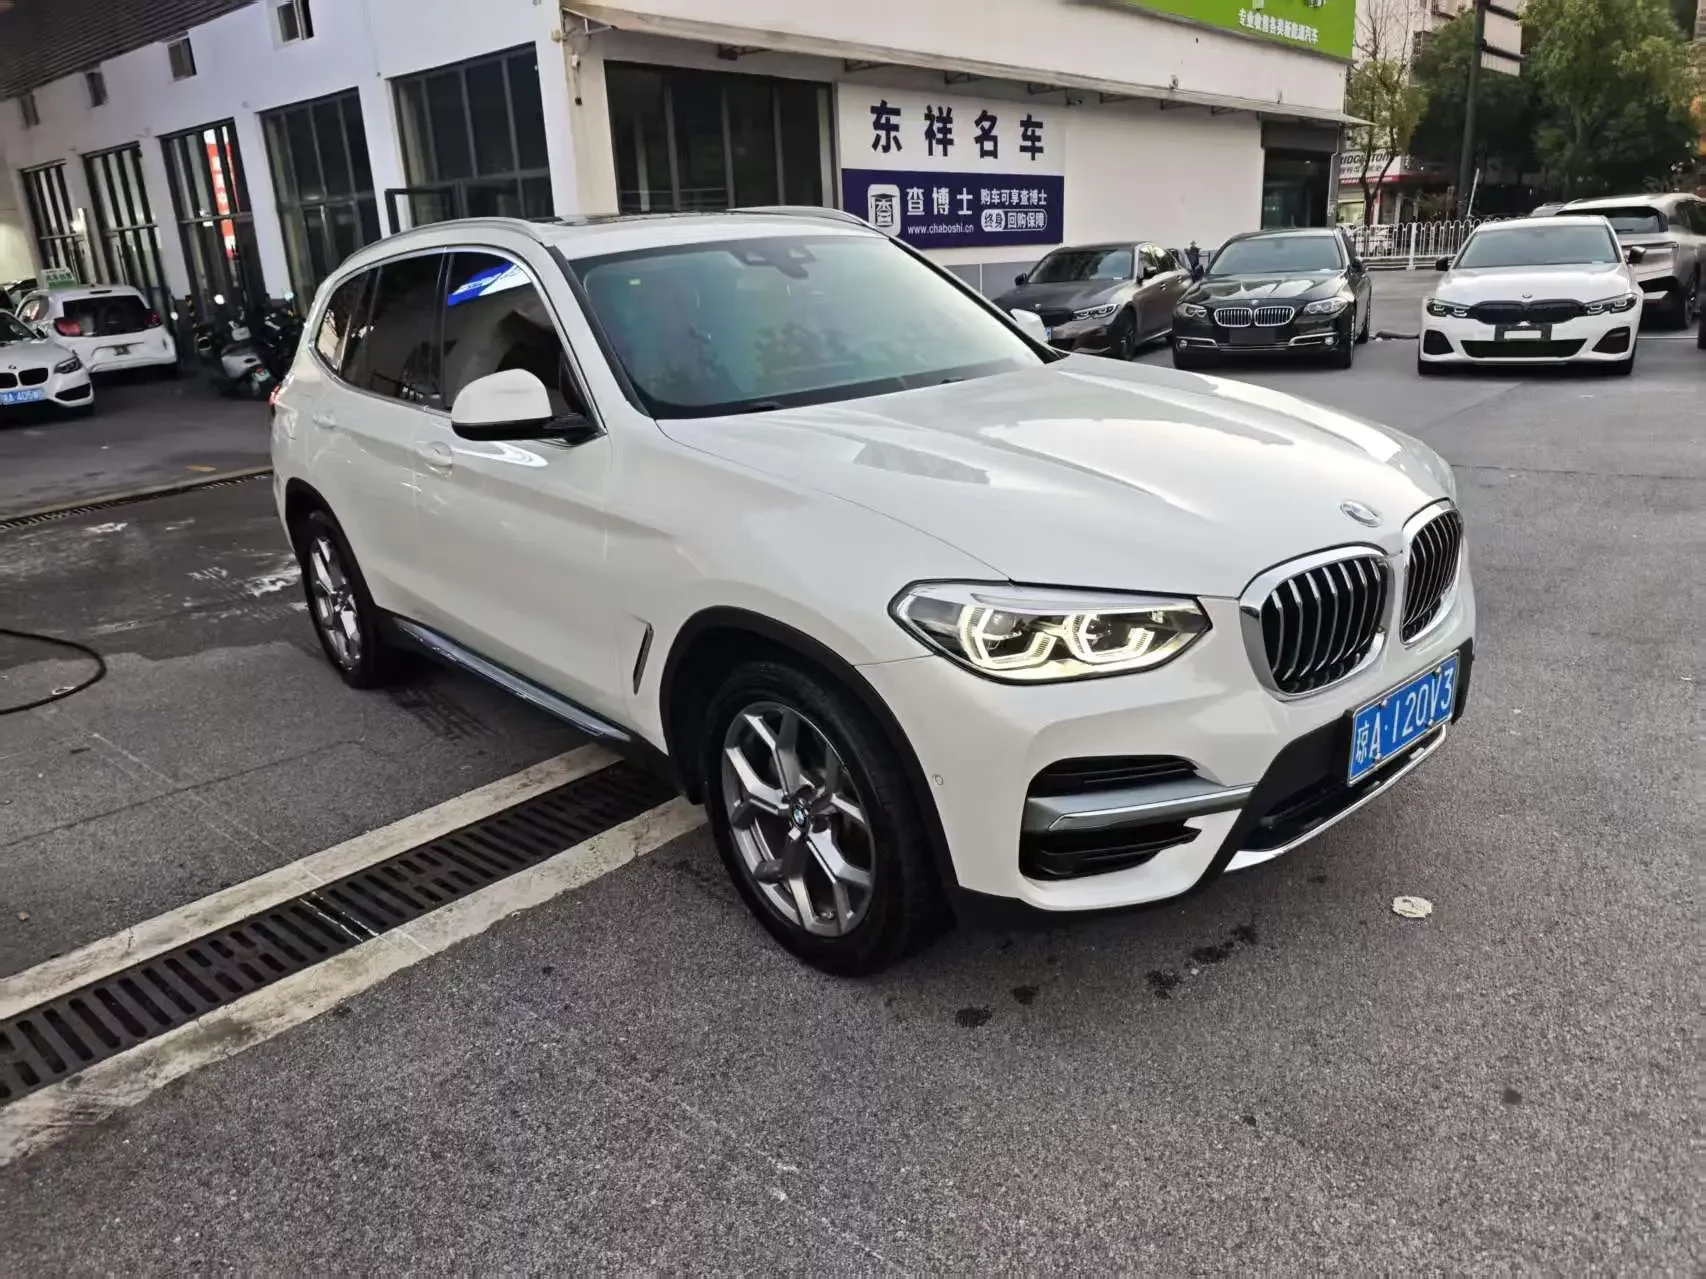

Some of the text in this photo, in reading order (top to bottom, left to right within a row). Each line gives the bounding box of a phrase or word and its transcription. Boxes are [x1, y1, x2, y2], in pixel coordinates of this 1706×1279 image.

[870, 99, 1044, 161] 东祥名车
[906, 187, 973, 216] 查博士
[980, 188, 1048, 206] 购车可享查博士
[907, 223, 974, 235] www.chaboshi.cn
[1007, 211, 1045, 229] 回购保障
